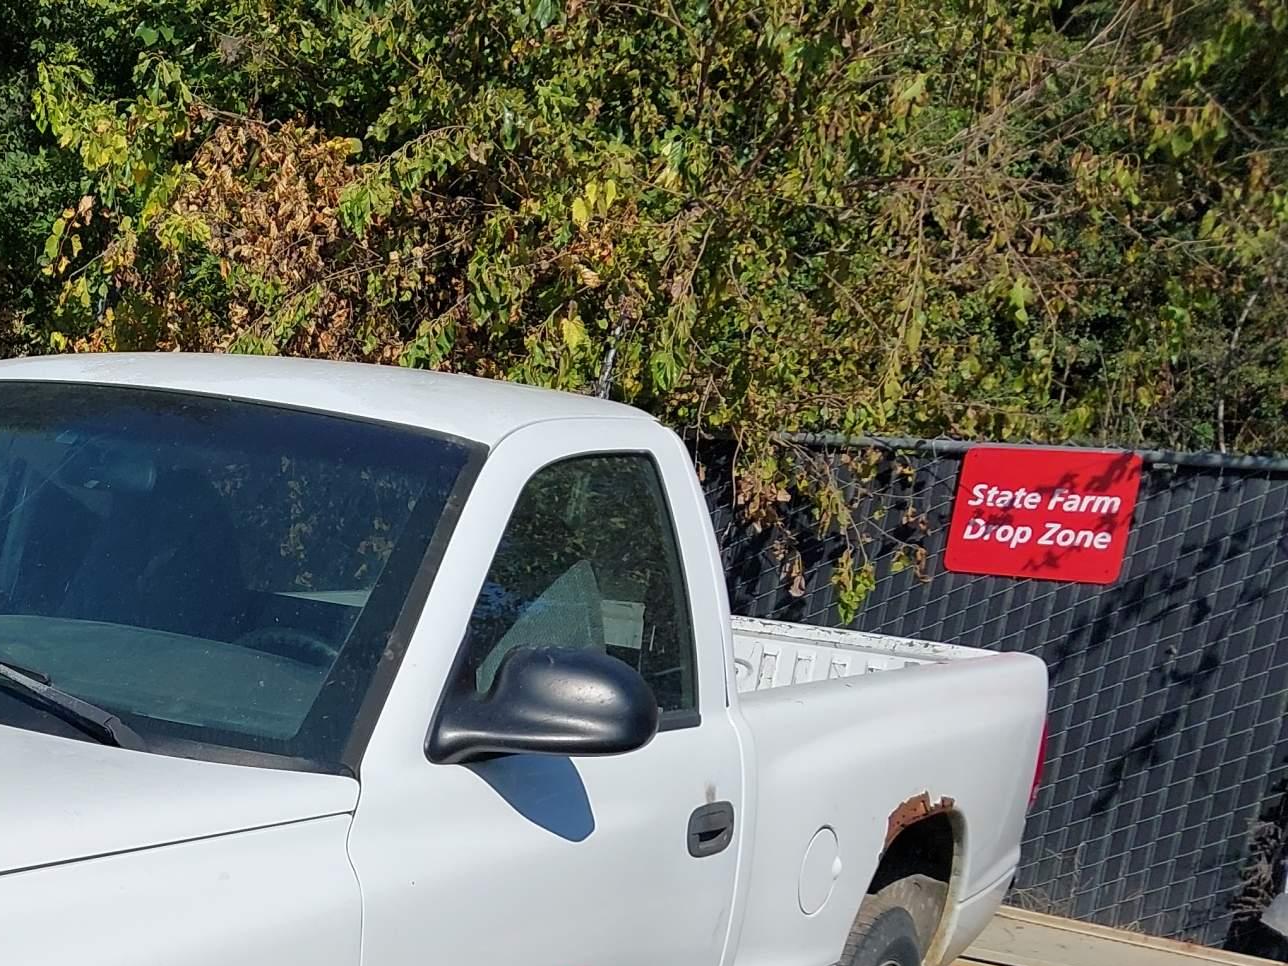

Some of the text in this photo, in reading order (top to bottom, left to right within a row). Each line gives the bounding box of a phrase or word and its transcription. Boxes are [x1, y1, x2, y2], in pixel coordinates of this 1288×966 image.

[968, 484, 1121, 513] State Farm
[963, 518, 1112, 549] Drop Zone
